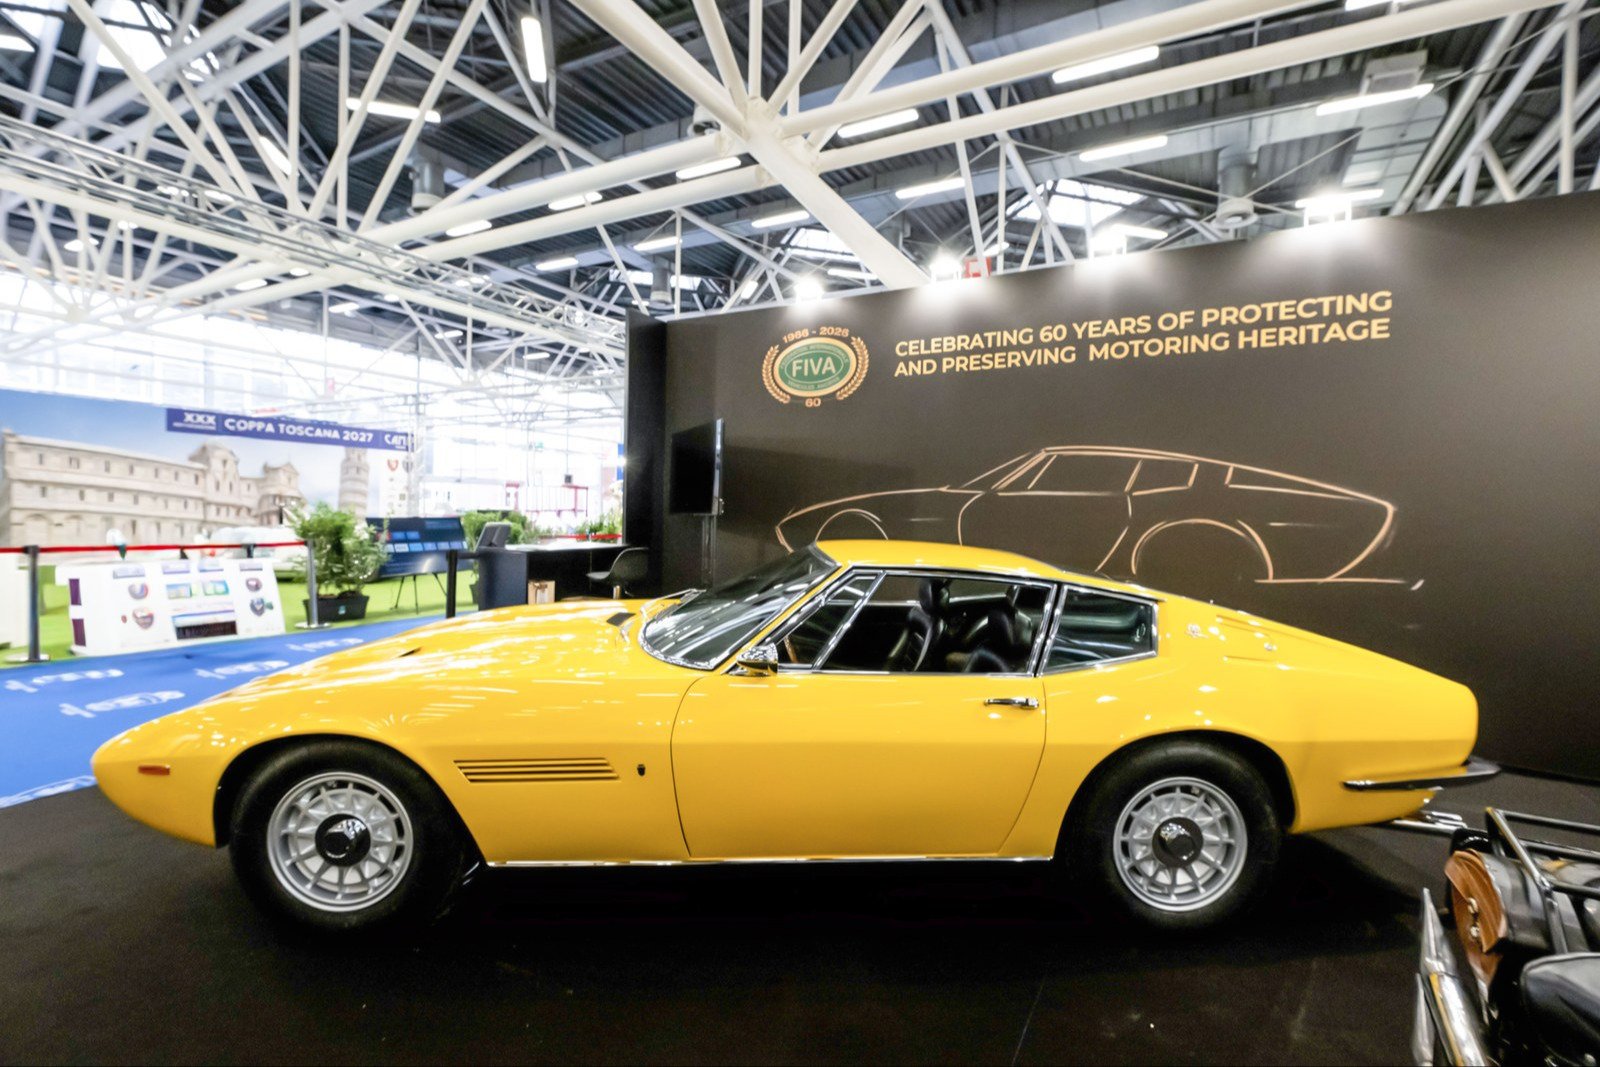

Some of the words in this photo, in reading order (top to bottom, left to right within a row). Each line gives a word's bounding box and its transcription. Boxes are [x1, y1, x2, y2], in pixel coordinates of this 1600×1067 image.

[895, 327, 1034, 357] CELEBRATING
[1039, 324, 1068, 343] 60
[1072, 314, 1152, 340] YEARS
[1157, 310, 1196, 332] OF
[1201, 290, 1393, 328] PROTECTING
[894, 359, 938, 377] AND
[941, 346, 1077, 373] PRESERVING
[1088, 332, 1230, 362] MOTORING
[1237, 317, 1391, 349] HERITAGE
[791, 356, 837, 378] FIVA
[805, 397, 822, 407] 60
[224, 418, 276, 434] COPPA
[278, 424, 341, 440] TOSCANA
[342, 430, 374, 443] 2027
